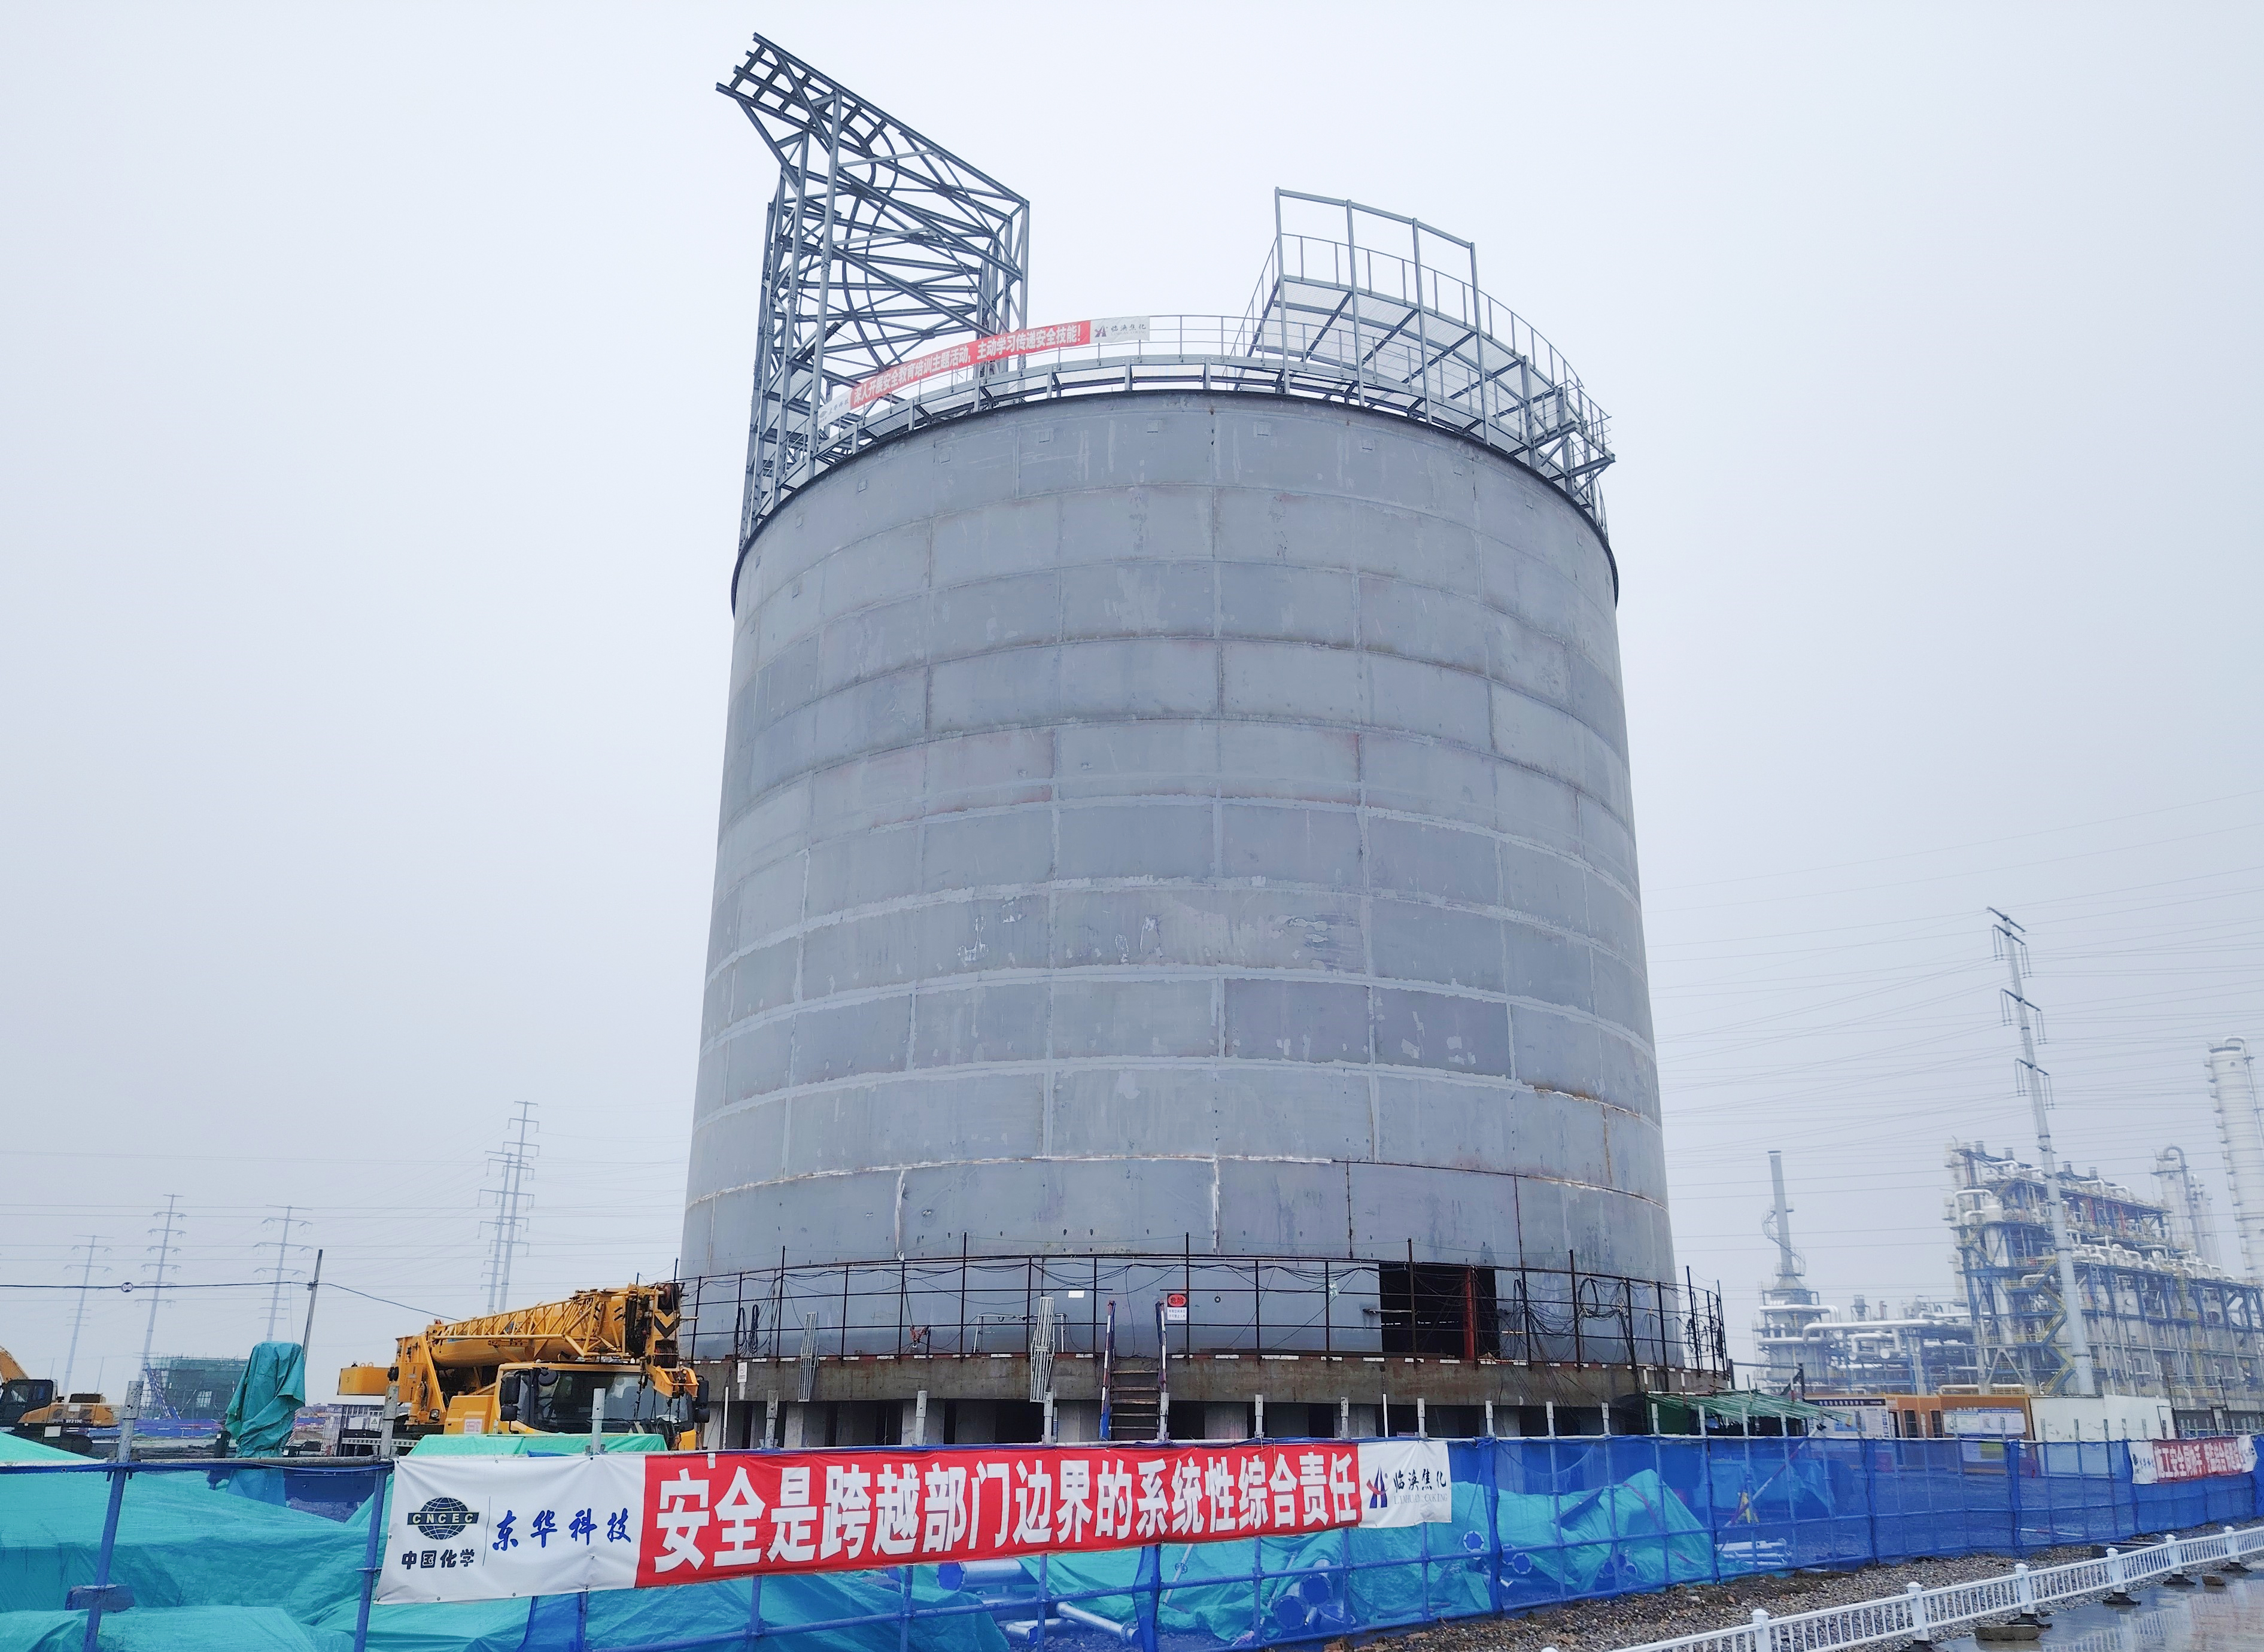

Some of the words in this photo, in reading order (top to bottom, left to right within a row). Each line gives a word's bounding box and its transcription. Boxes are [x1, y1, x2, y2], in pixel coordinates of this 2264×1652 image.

[412, 1513, 474, 1525] CNCEC
[492, 1507, 631, 1551] 东华科技
[655, 1452, 1357, 1573] 安全是跨越部门边界的系统性综合责任
[401, 1548, 475, 1570] 中国化学
